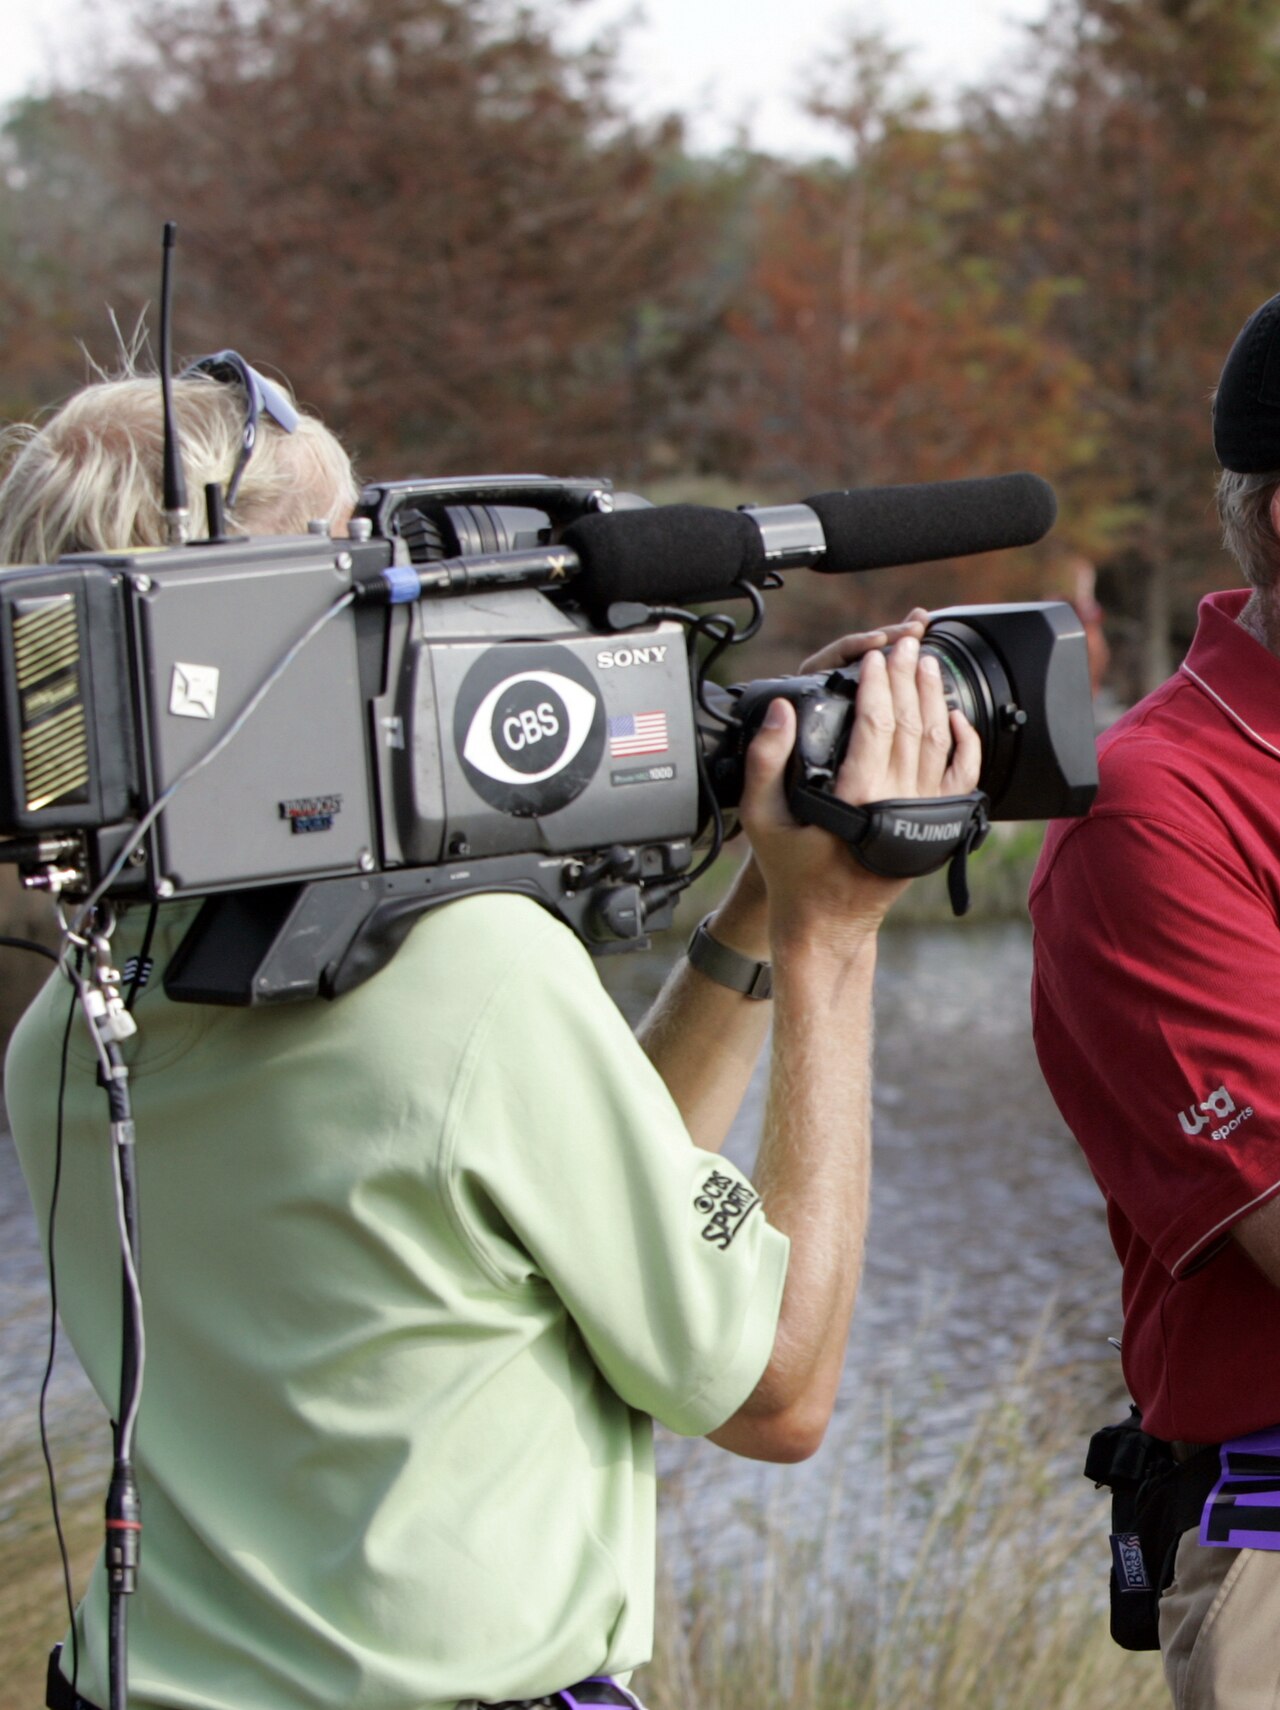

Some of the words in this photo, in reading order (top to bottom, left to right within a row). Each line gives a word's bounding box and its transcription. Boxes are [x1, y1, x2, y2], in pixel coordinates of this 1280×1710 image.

[597, 646, 668, 669] SONY
[503, 702, 560, 751] CBS
[893, 818, 962, 842] FUJINON
[1211, 1106, 1254, 1140] sports
